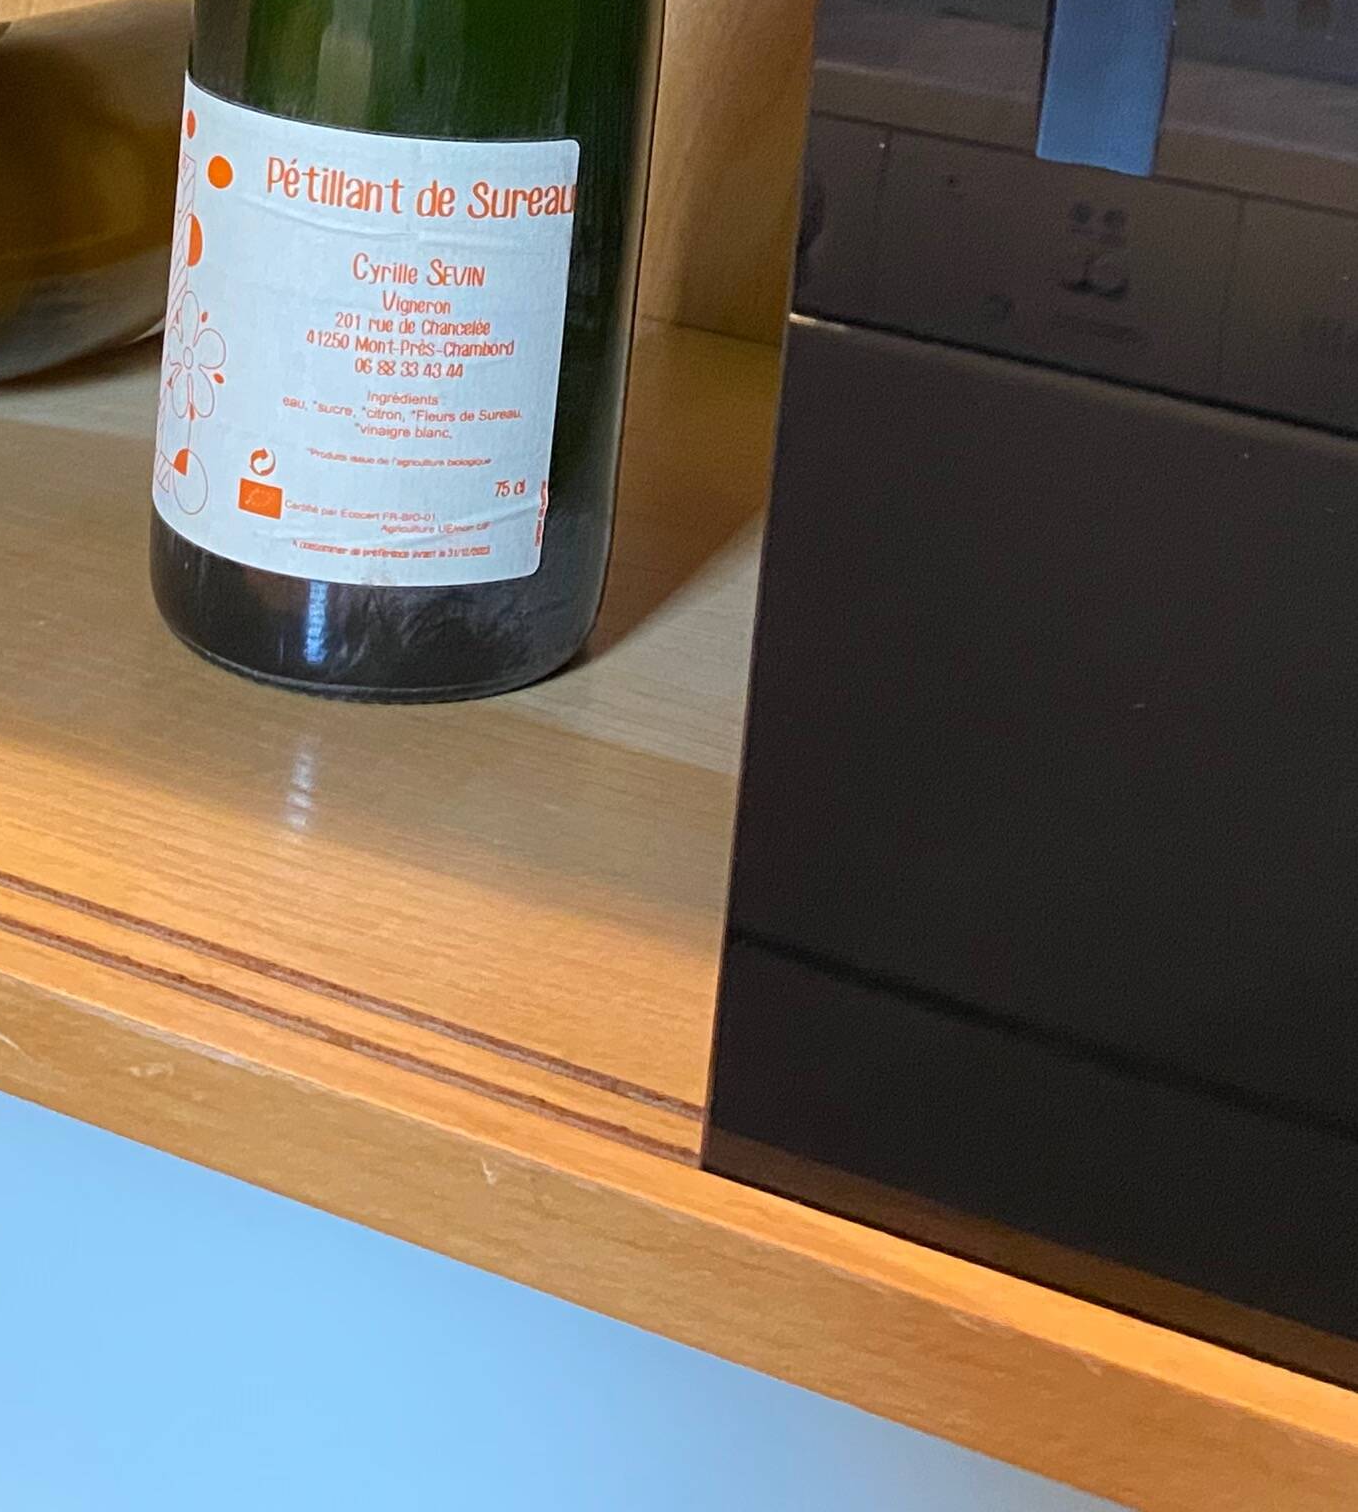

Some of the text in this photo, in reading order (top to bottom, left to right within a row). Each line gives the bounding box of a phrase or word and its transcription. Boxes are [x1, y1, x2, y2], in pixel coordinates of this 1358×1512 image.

[266, 156, 578, 221] Pétillant de Sureau
[353, 252, 486, 287] Cyrille SEVIN
[382, 290, 451, 317] Vigneron
[335, 312, 491, 337] 201 rue de Chancelée
[306, 329, 349, 349] 41250
[354, 358, 464, 379] 06 88 33 43 44
[459, 409, 475, 421] de
[495, 479, 510, 497] 75
